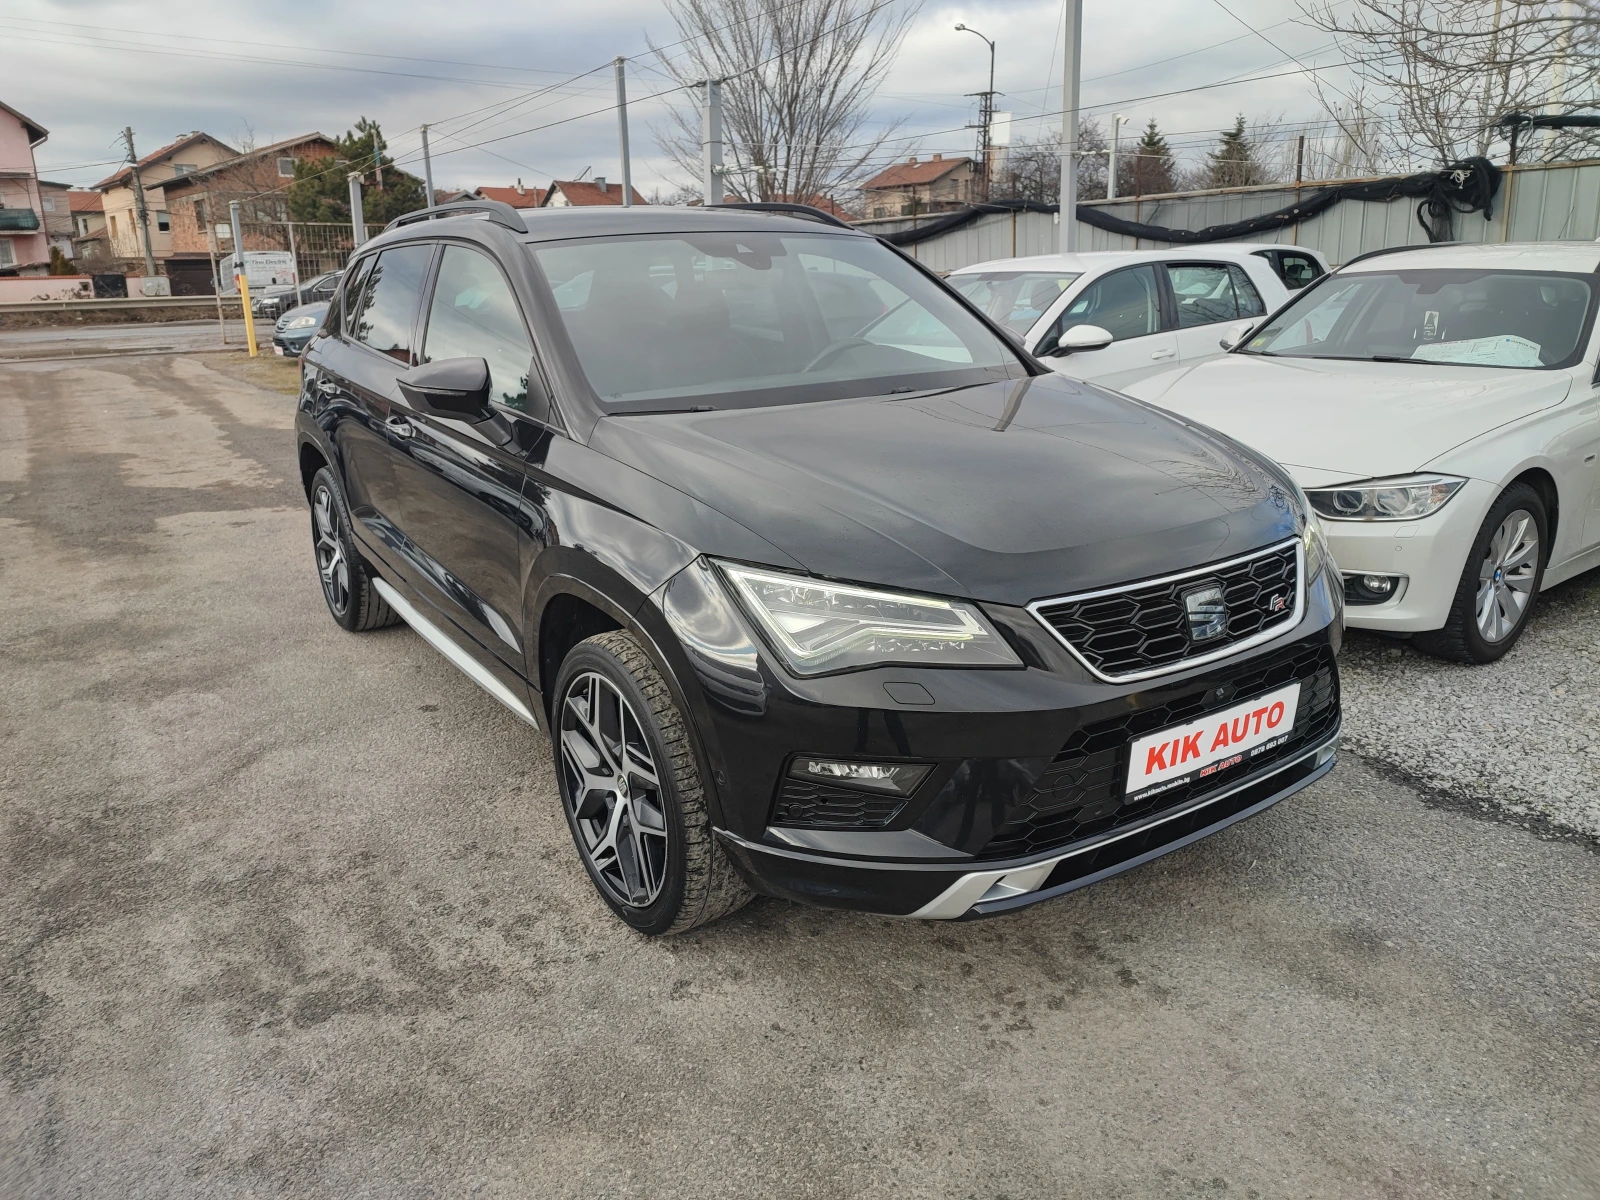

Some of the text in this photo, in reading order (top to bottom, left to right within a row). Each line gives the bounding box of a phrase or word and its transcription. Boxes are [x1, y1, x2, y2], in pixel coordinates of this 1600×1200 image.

[1144, 700, 1285, 775] KIK AUTO
[1200, 755, 1243, 777] KIK AUTO
